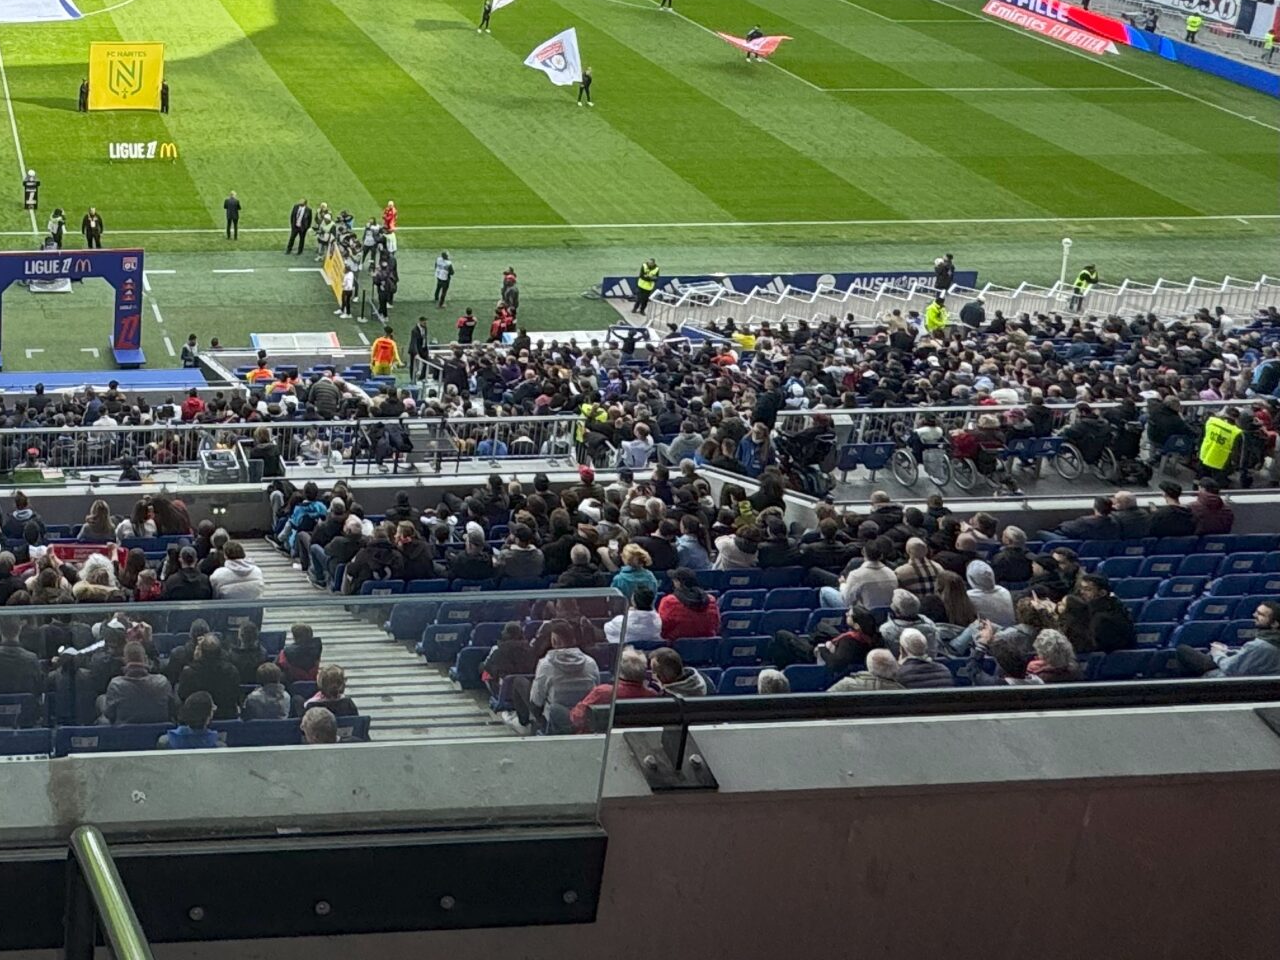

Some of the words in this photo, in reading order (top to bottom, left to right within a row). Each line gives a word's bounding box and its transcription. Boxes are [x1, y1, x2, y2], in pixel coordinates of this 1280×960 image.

[987, 0, 1048, 31] Emirates
[1048, 22, 1069, 38] FLY
[1066, 28, 1107, 52] BETTER
[117, 50, 147, 58] NANTES
[109, 143, 147, 159] LIGUE
[25, 260, 60, 274] LIGUE
